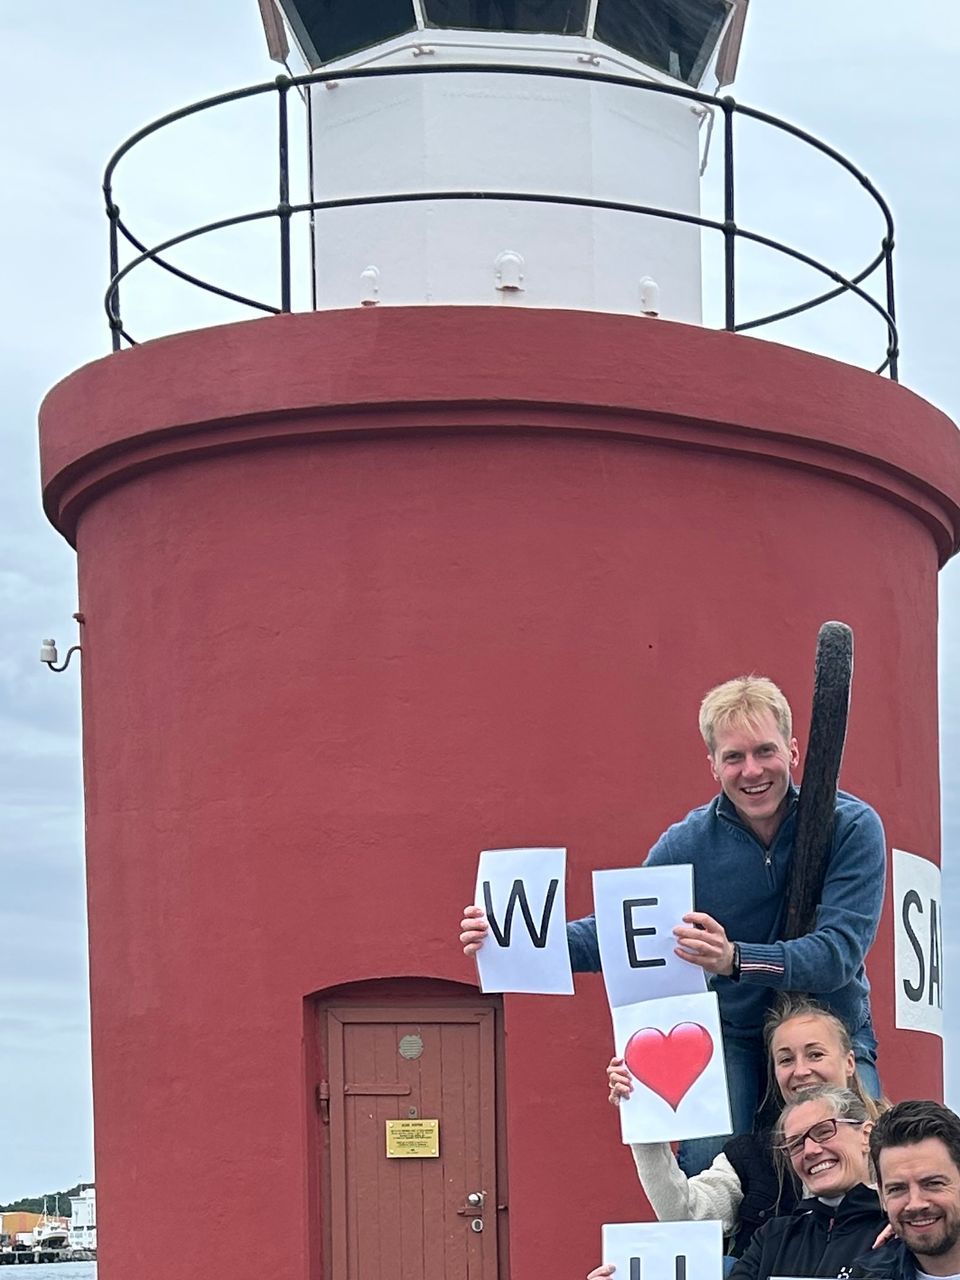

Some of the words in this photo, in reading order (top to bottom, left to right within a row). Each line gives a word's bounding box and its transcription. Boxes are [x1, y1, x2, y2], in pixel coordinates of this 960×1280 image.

[483, 879, 558, 948] W
[623, 898, 666, 968] E
[902, 888, 943, 1009] SA
